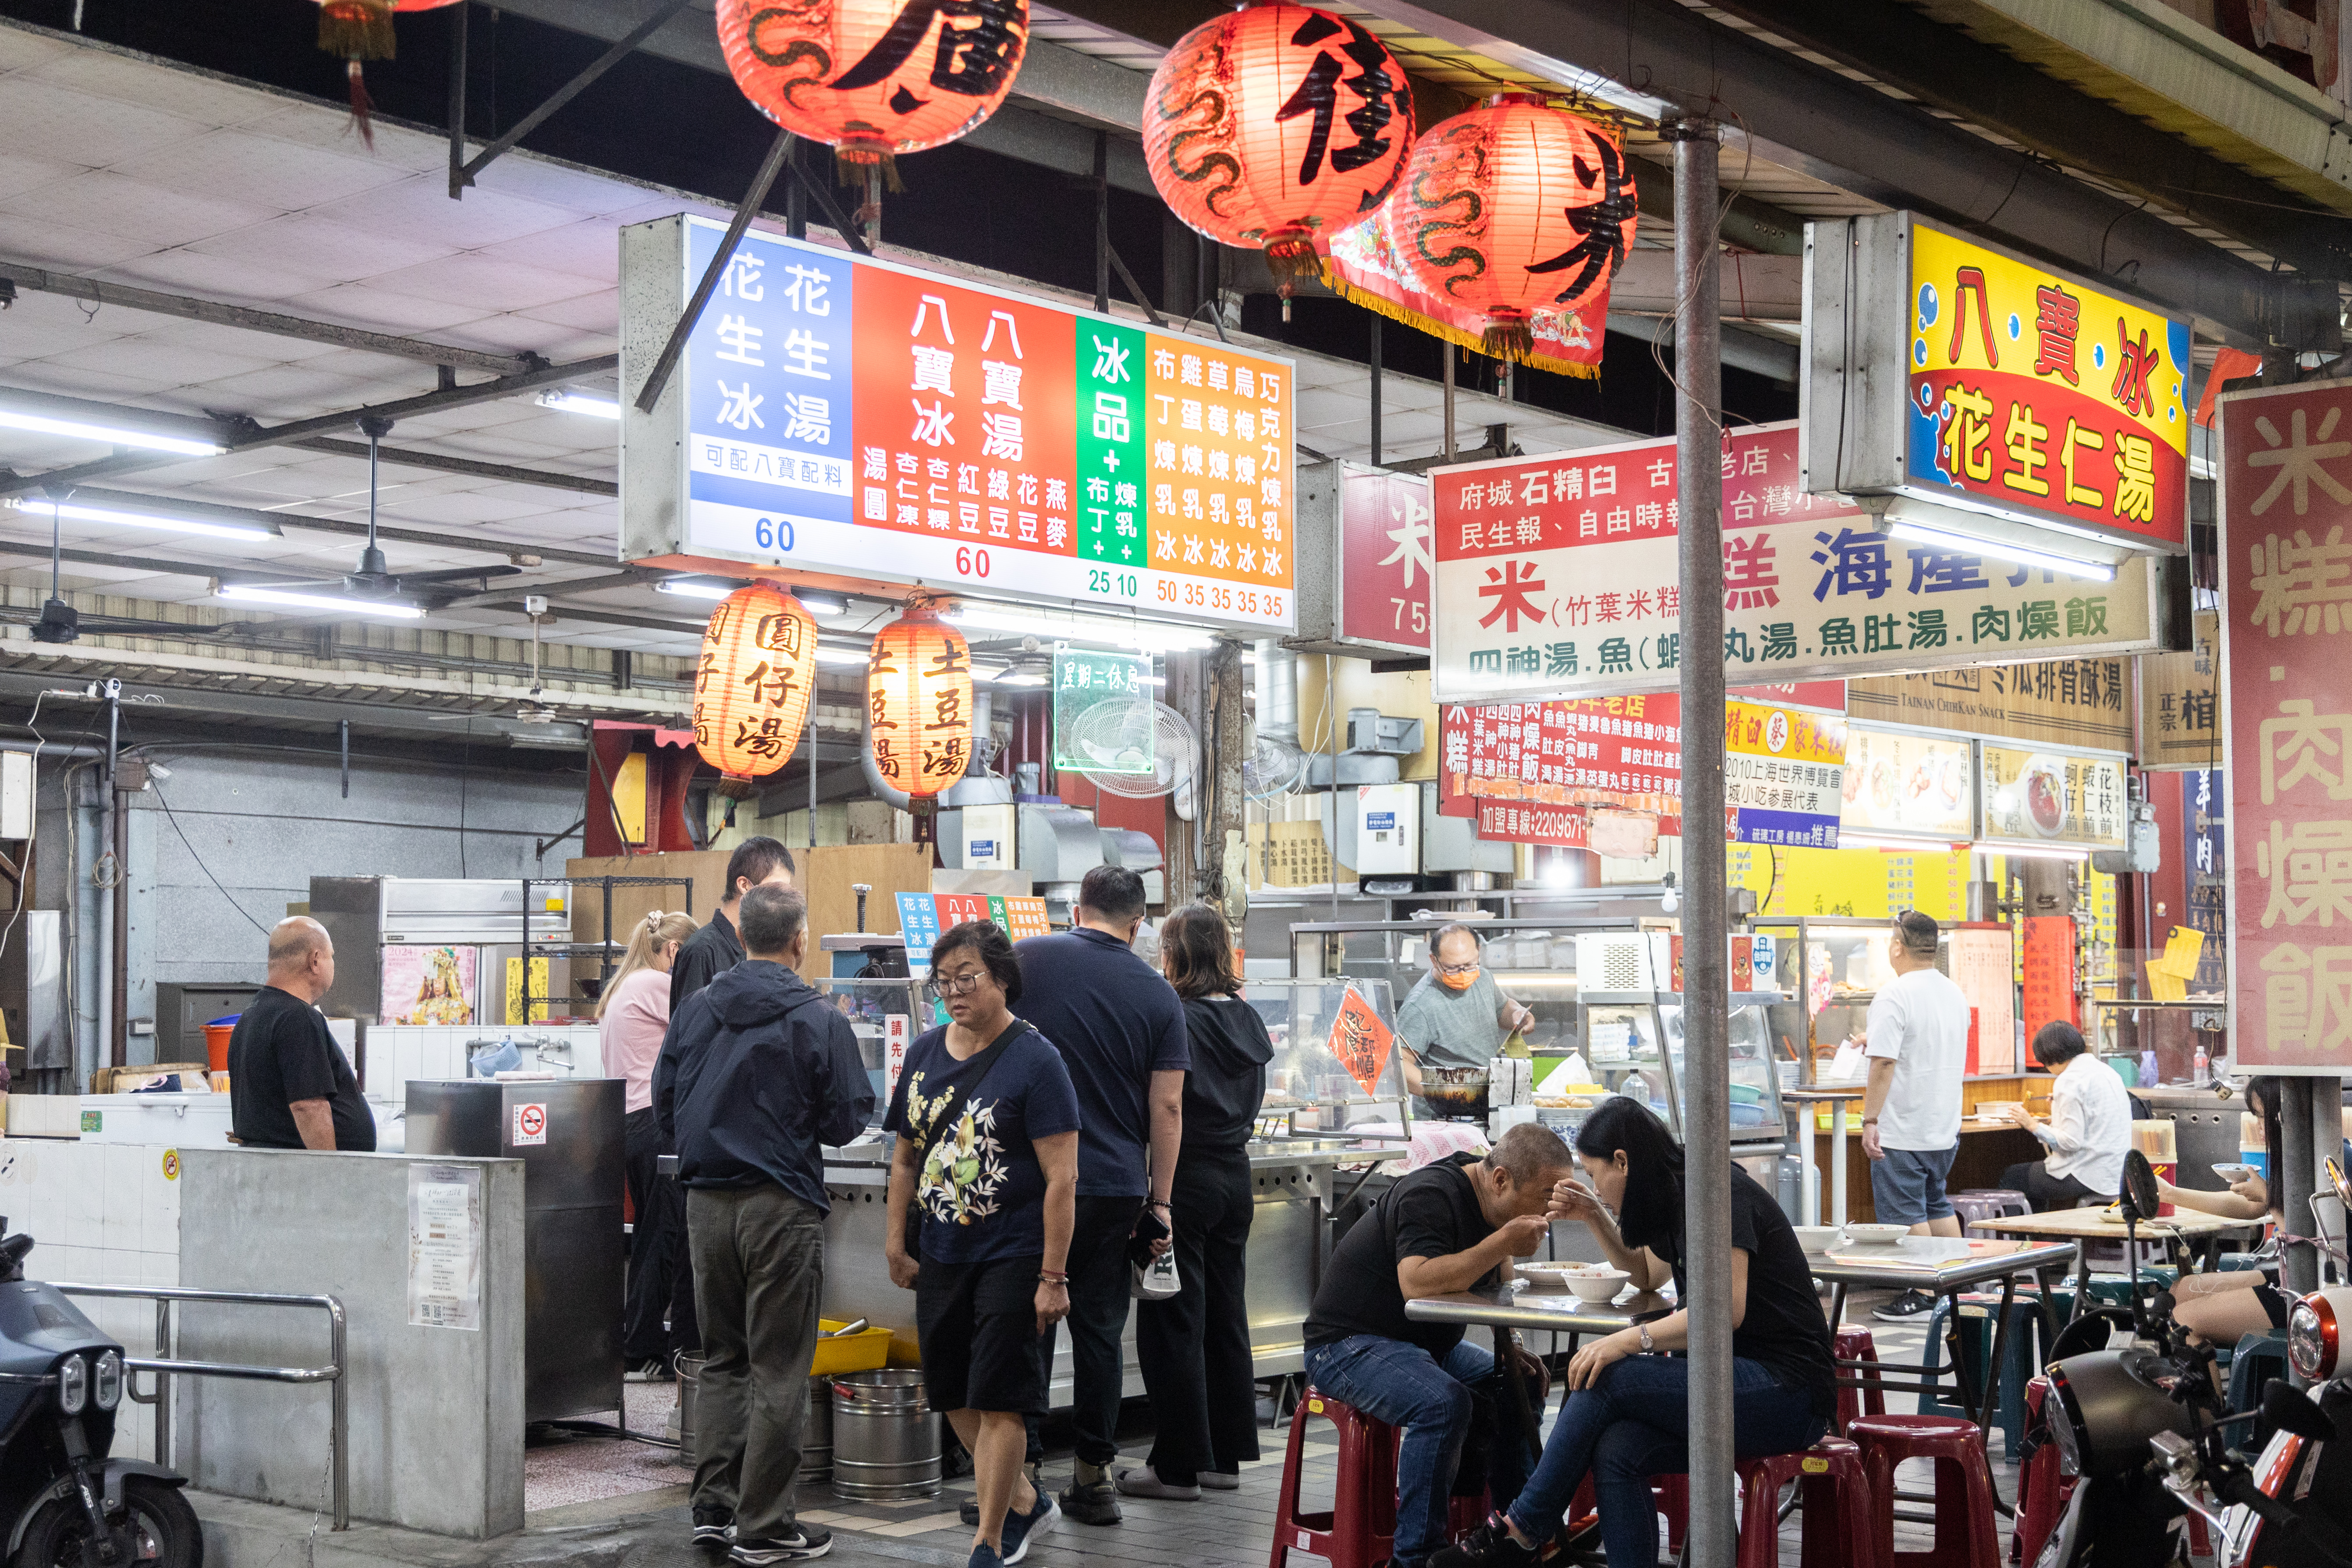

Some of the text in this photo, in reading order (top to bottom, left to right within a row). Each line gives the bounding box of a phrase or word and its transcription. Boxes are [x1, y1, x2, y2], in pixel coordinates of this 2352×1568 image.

[716, 252, 765, 430] 花生冰
[784, 263, 831, 445] 花生湯
[911, 295, 955, 447] 八寶冰
[1949, 266, 2159, 417] 八寶冰
[981, 311, 1024, 463] 八寶湯
[706, 443, 842, 488] 可配八寶配料
[864, 446, 887, 520] 湯圓
[1943, 381, 2155, 524] 花生仁湯
[896, 452, 919, 527] 杏仁凍
[927, 458, 950, 531] 杏仁粿
[958, 462, 980, 534] 紅豆
[987, 468, 1010, 539] 綠豆
[1017, 473, 1039, 543] 花豆
[1046, 478, 1067, 549] 燕麥
[756, 518, 795, 551] 60
[956, 547, 990, 578] 60
[1089, 570, 1137, 597] 25 10
[1157, 580, 1282, 617] 50 35 35 35 35
[1479, 560, 1547, 633] 米
[734, 613, 802, 759] 圓仔湯
[923, 639, 970, 777] 土豆湯
[1061, 661, 1140, 693] 星期二休息
[388, 947, 412, 956] 2024
[903, 897, 922, 946] 花生冰
[891, 1020, 902, 1096] 請先付
